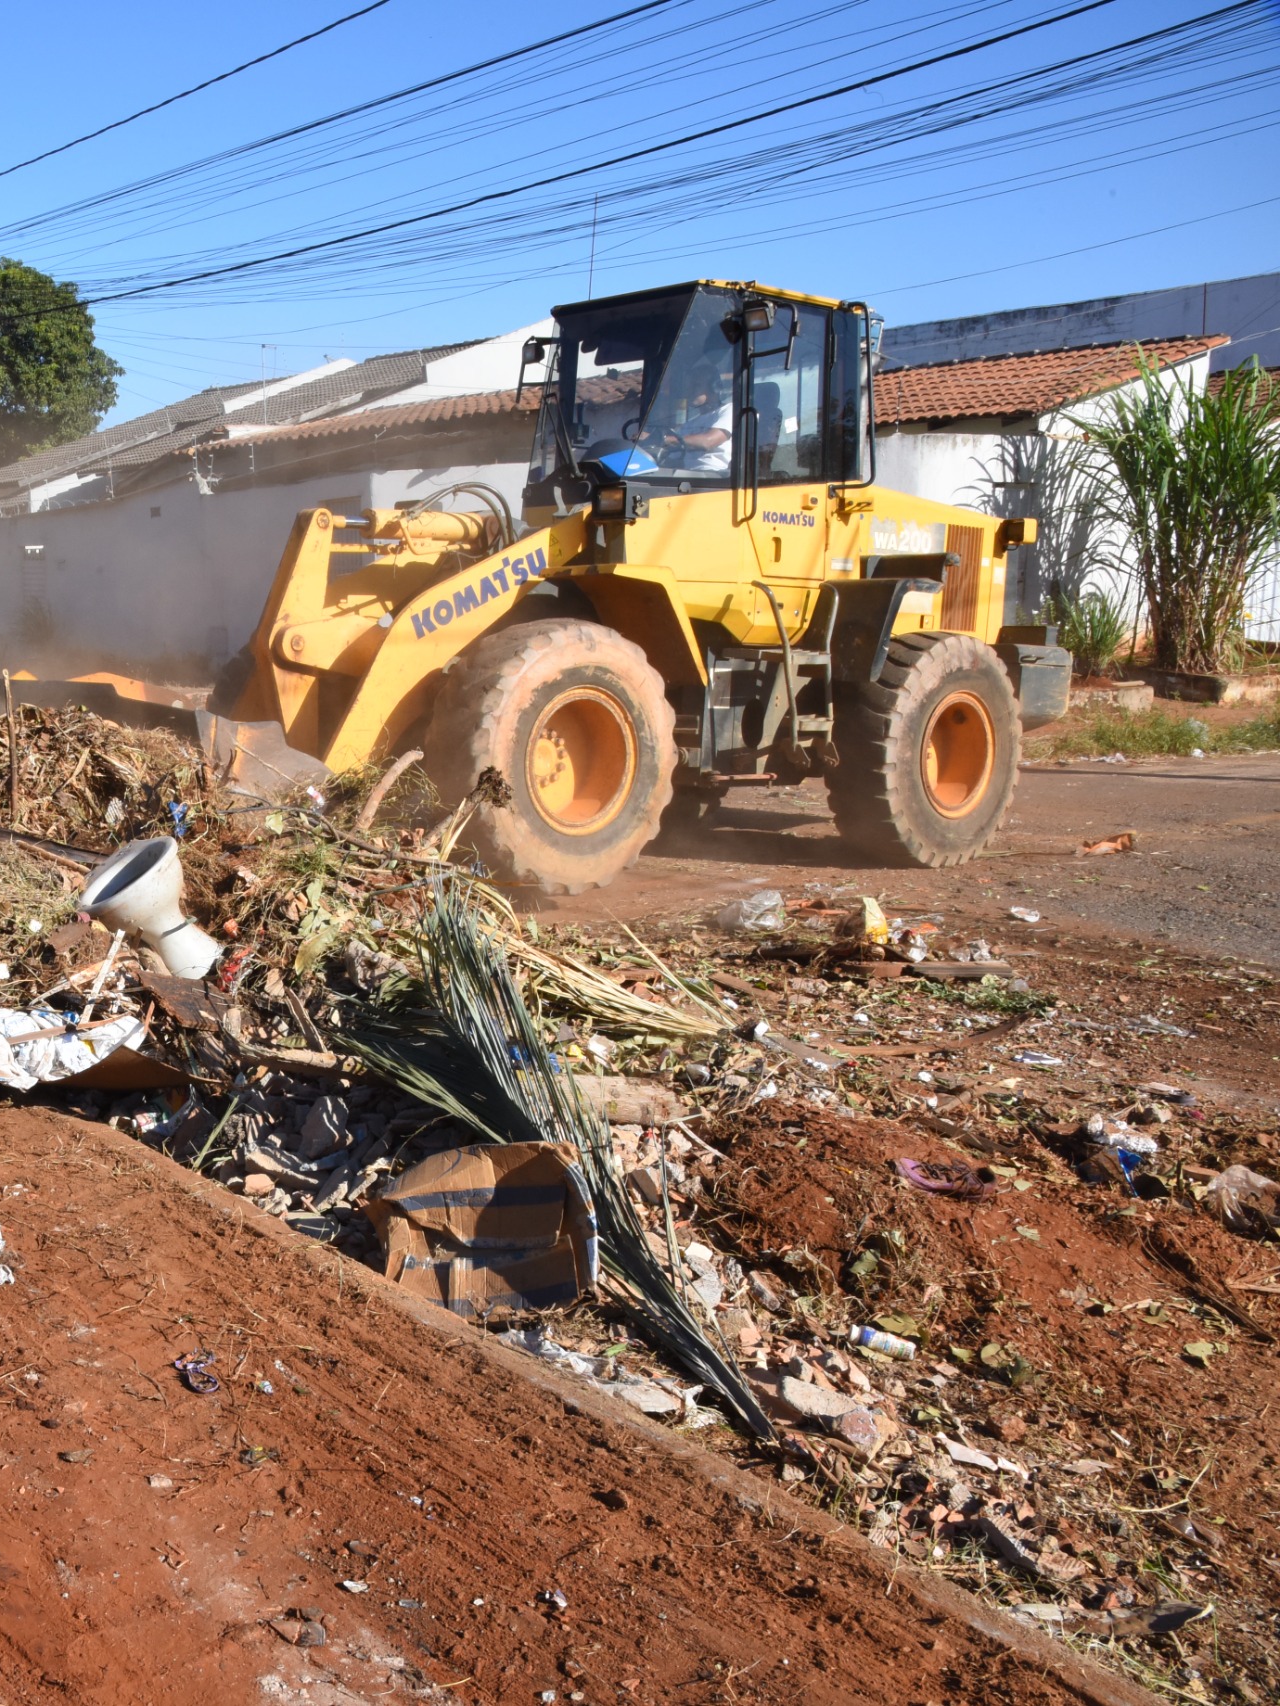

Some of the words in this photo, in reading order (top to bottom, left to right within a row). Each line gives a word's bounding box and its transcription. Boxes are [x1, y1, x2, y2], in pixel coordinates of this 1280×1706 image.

[763, 511, 814, 527] KOMATSU
[874, 530, 932, 553] WA200
[411, 547, 547, 640] KOMATSU
